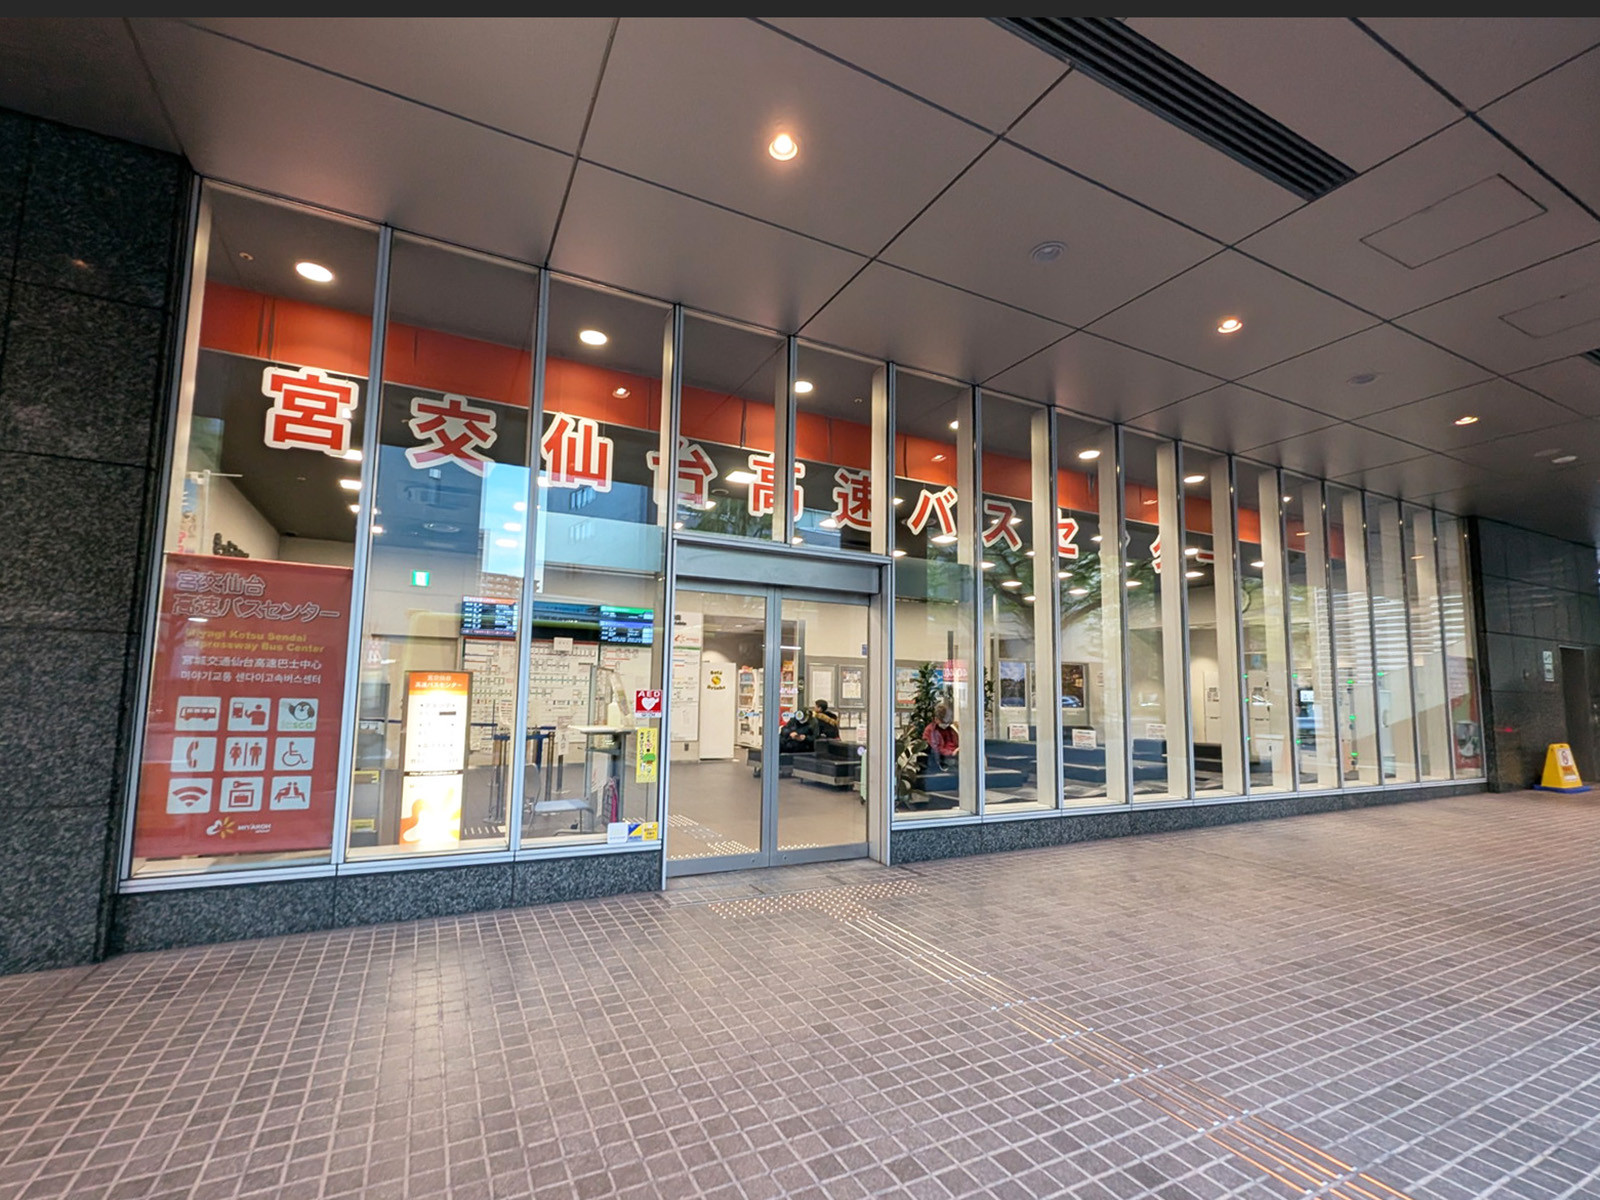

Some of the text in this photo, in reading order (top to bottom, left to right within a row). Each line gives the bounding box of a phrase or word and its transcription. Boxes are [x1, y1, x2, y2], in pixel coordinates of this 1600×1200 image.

[177, 570, 265, 596] 宮交仙台
[172, 594, 341, 622] 高速バスセンター
[267, 631, 307, 643] Sendai
[185, 641, 325, 654] pressway Bus Center
[637, 690, 661, 699] AED
